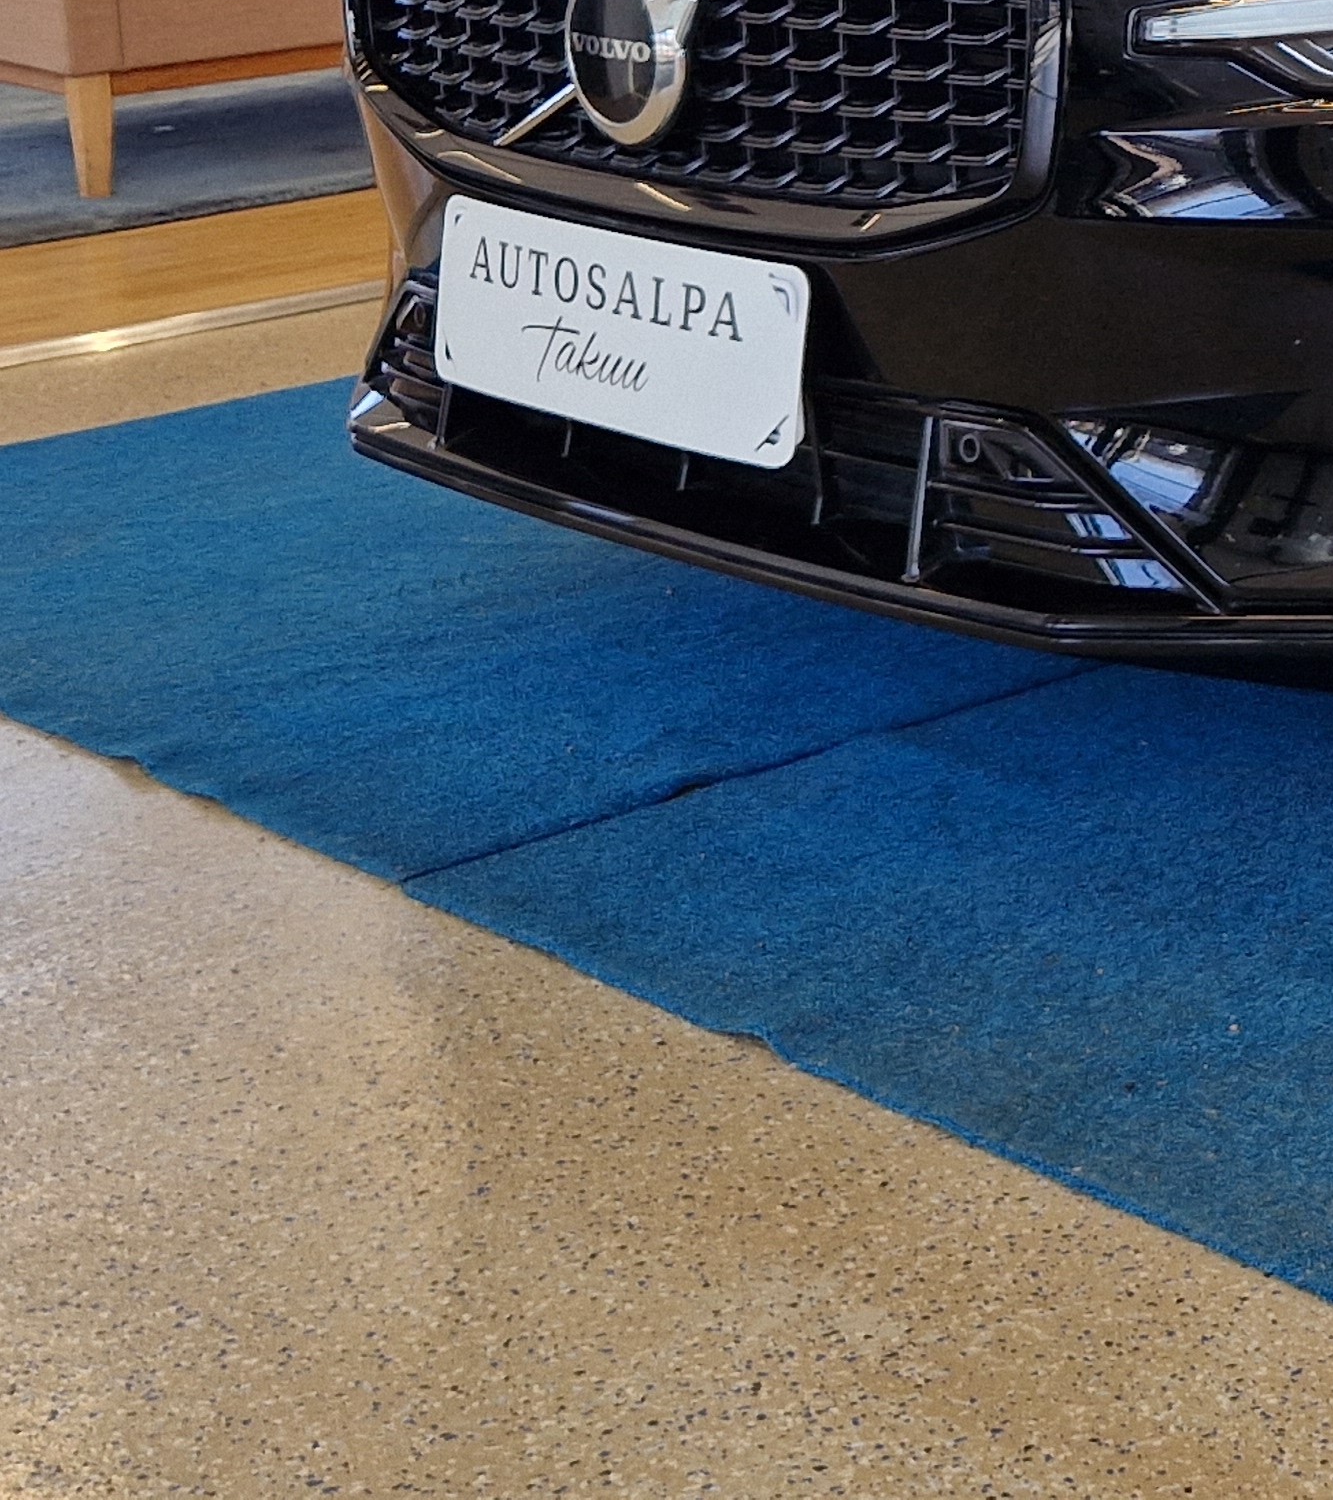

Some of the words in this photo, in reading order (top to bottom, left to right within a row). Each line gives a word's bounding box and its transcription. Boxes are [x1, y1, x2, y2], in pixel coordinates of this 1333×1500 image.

[571, 31, 652, 63] VOLVO
[469, 236, 743, 342] AUTOSALPA
[522, 315, 650, 393] Takuu
